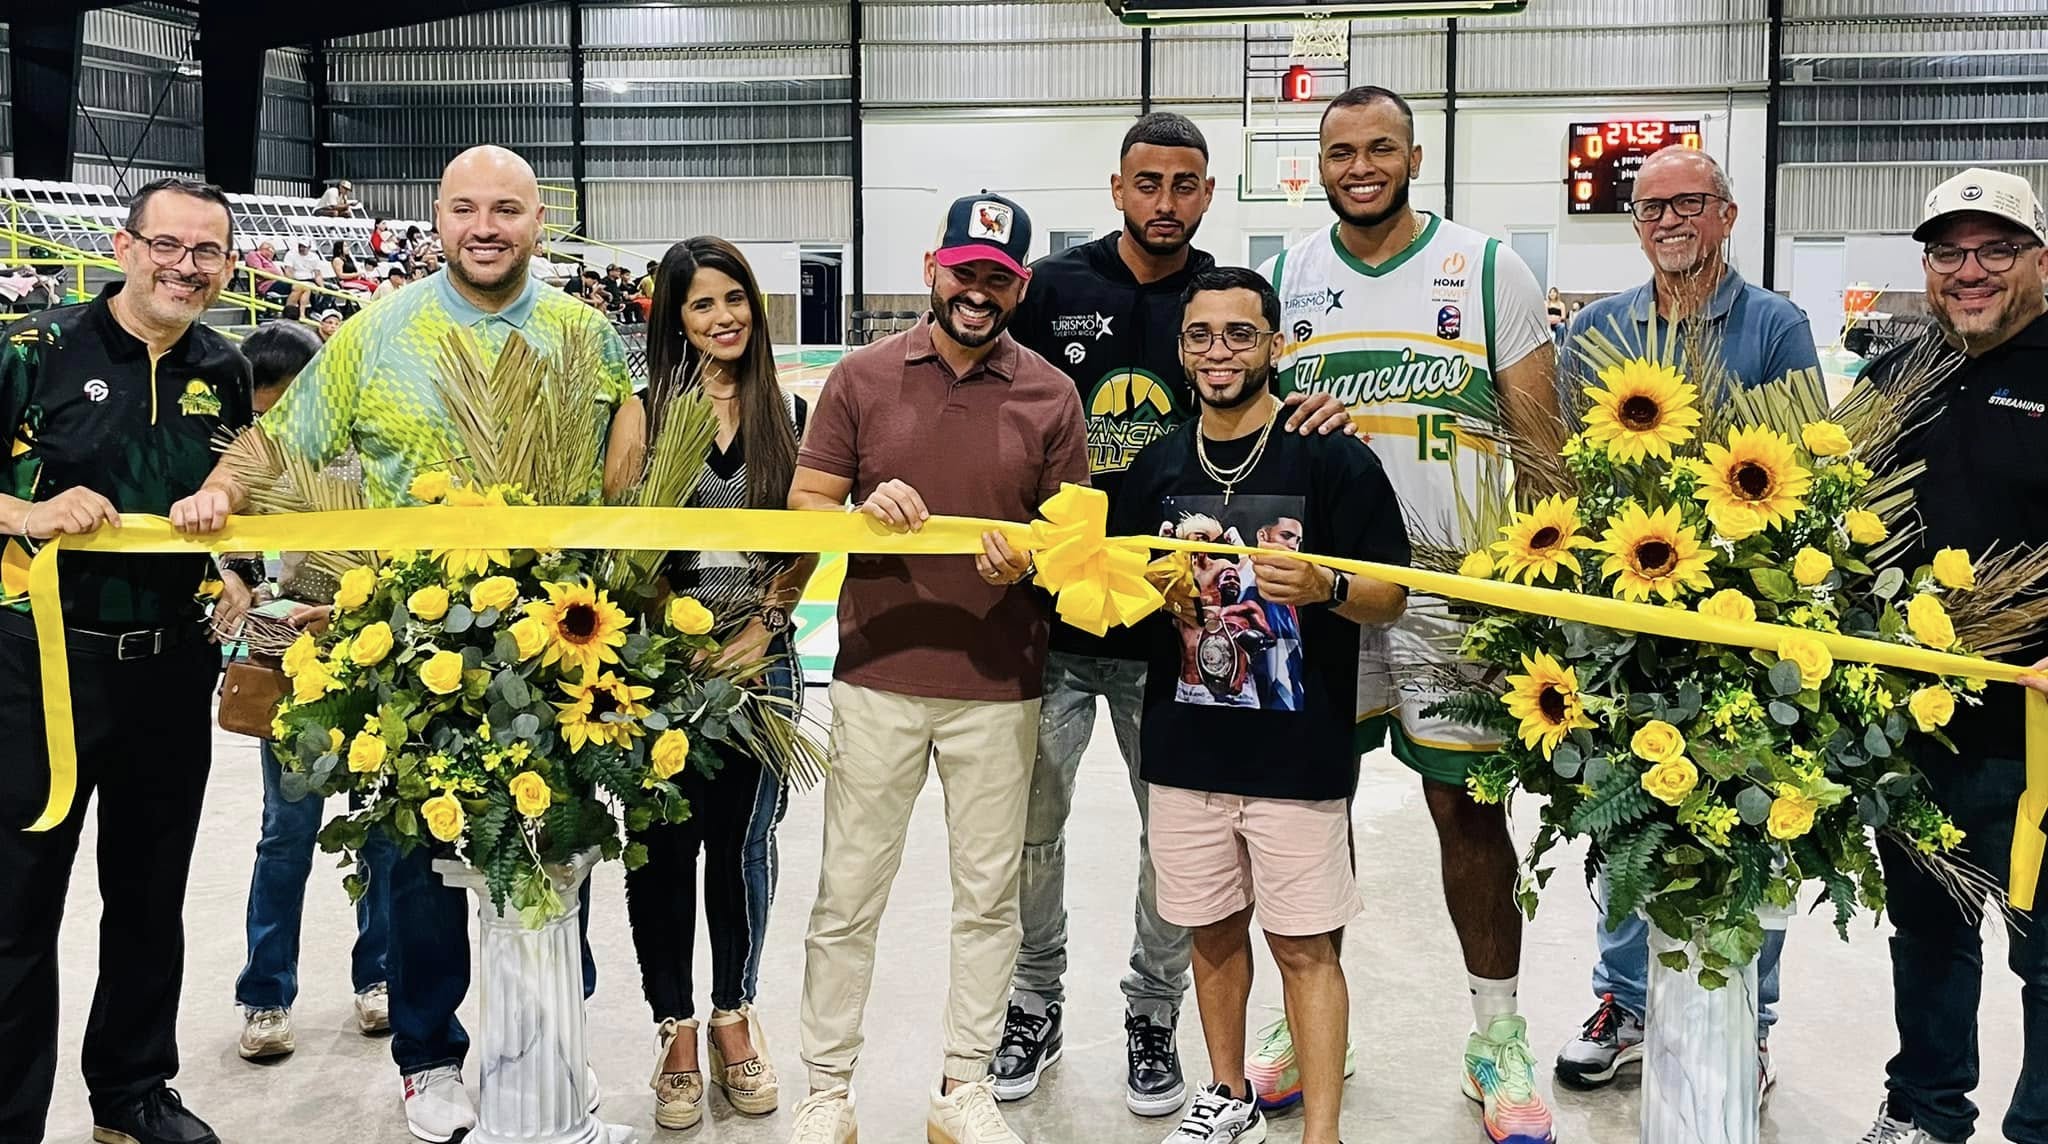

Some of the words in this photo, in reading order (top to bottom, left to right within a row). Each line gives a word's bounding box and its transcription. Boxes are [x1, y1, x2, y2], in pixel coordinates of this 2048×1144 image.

[1295, 73, 1311, 99] 0
[1587, 135, 1603, 158] 0
[1051, 319, 1096, 331] TURISMO
[1988, 395, 2045, 412] STREAMING
[1417, 413, 1457, 461] 15
